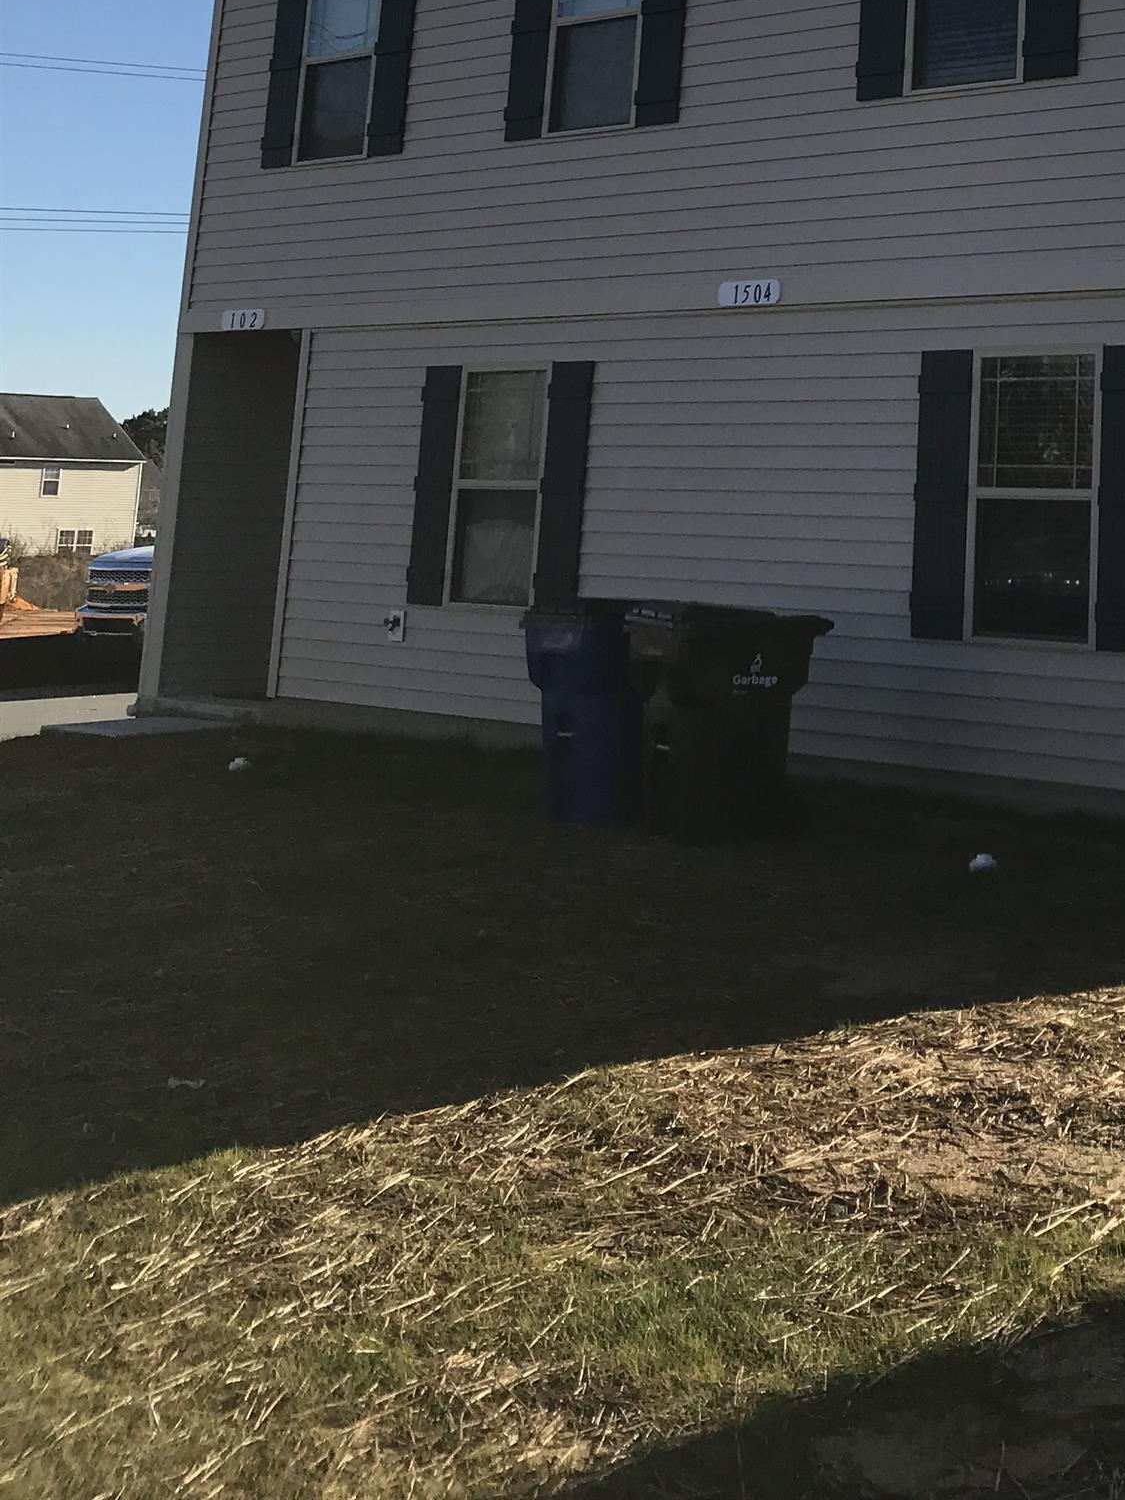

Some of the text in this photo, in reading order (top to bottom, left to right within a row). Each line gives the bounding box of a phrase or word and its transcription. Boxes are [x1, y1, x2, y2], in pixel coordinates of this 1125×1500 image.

[733, 282, 772, 304] 1504
[230, 312, 257, 328] 102
[733, 674, 778, 688] Garbage
